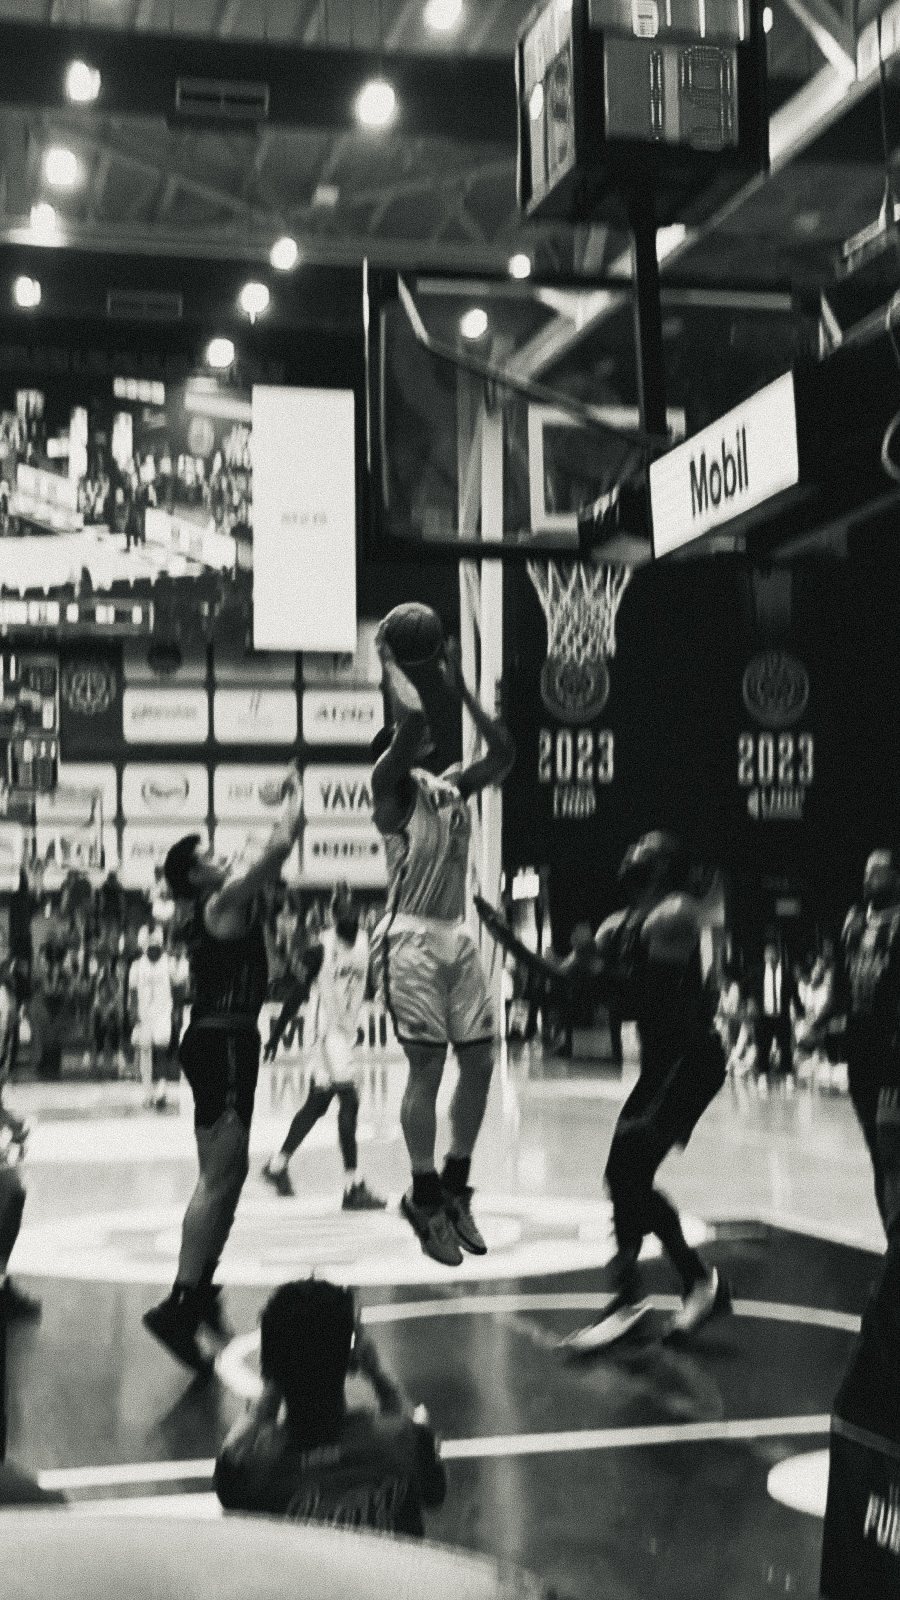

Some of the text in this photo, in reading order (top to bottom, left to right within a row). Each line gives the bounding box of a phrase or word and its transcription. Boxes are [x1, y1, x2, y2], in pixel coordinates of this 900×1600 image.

[689, 423, 749, 518] Mobil
[539, 728, 614, 784] 2023
[738, 733, 813, 786] 2023
